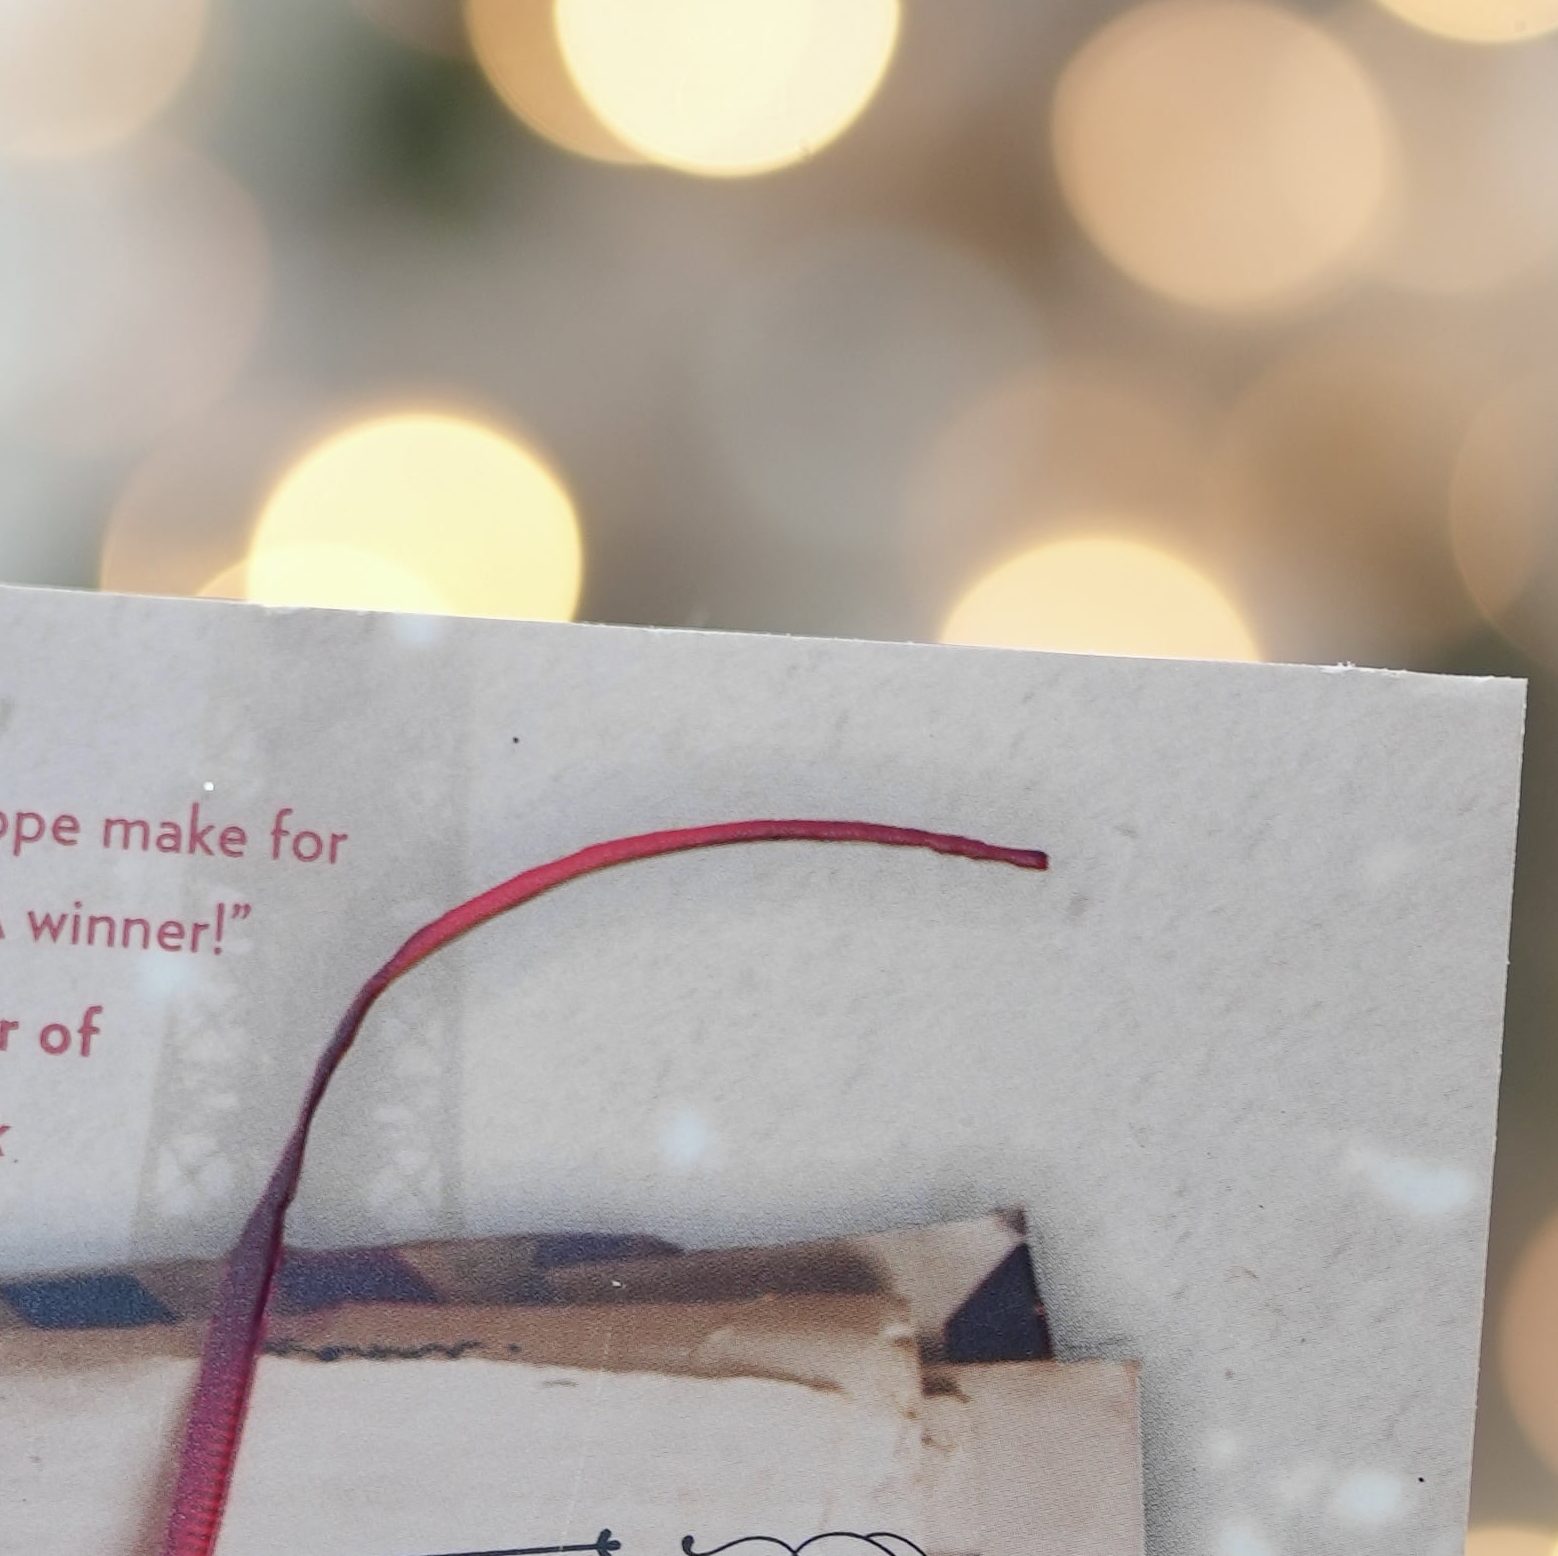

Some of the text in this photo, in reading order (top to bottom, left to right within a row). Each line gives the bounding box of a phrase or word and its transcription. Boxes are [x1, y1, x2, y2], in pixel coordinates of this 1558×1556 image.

[101, 801, 249, 858] make
[270, 805, 349, 865] for
[26, 901, 252, 957] winner!”
[37, 1003, 104, 1058] of
